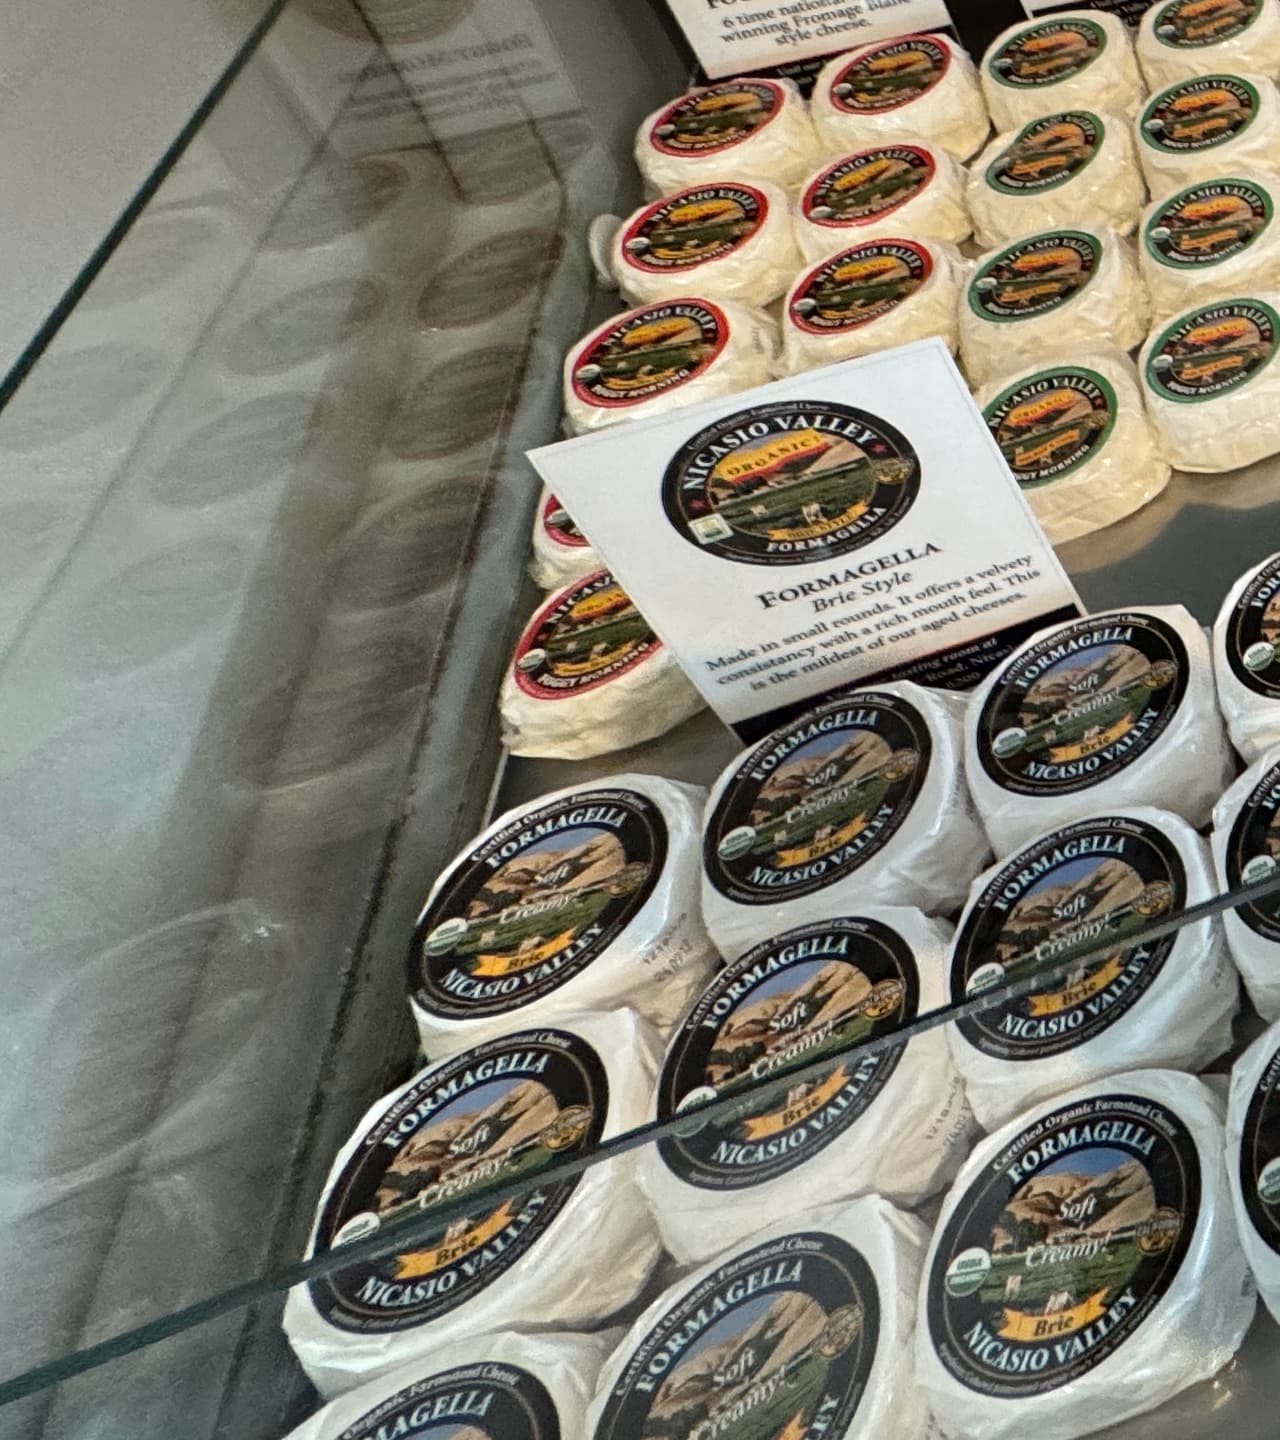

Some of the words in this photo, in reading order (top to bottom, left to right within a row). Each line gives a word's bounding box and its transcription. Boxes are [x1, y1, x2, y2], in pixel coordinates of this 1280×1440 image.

[721, 21, 789, 44] winning
[792, 4, 864, 30] Fromage
[737, 8, 775, 24] time
[775, 28, 812, 46] style
[815, 17, 872, 37] cheese.
[683, 419, 769, 492] NICASIO
[775, 413, 878, 446] VALLEY
[765, 505, 890, 555] FORMAGELLA
[755, 542, 942, 610] FORMAGELLA
[810, 587, 858, 613] Brie
[860, 569, 914, 596] Style
[705, 645, 758, 672] Made
[759, 640, 780, 653] in
[783, 621, 830, 645] small
[831, 603, 895, 635] rounds.
[899, 594, 914, 608] It
[915, 577, 963, 602] offers
[965, 574, 974, 585] a
[975, 554, 1034, 587] velvety
[717, 644, 816, 686] consistancy
[819, 628, 859, 651] with
[861, 626, 872, 635] a
[875, 610, 909, 631] rich
[911, 594, 966, 621] mouth
[968, 581, 1002, 600] feel.
[1003, 568, 1042, 586] This
[749, 678, 766, 692] is
[767, 668, 799, 686] the
[802, 644, 864, 674] mildest
[866, 636, 885, 651] of
[888, 628, 918, 644] our
[921, 612, 960, 635] aged
[963, 592, 1027, 619] cheeses.
[486, 806, 630, 868] FORMAGELLA
[439, 967, 521, 1000] NICASIO
[522, 923, 605, 988] VALLEY
[1006, 1121, 1158, 1184] FORMAGELLA
[1058, 1195, 1098, 1222] Soft
[1025, 1232, 1112, 1269] Creamy!
[963, 1321, 1050, 1372] NICASIO
[1053, 1287, 1138, 1364] VALLEY
[1032, 1316, 1074, 1338] Brie
